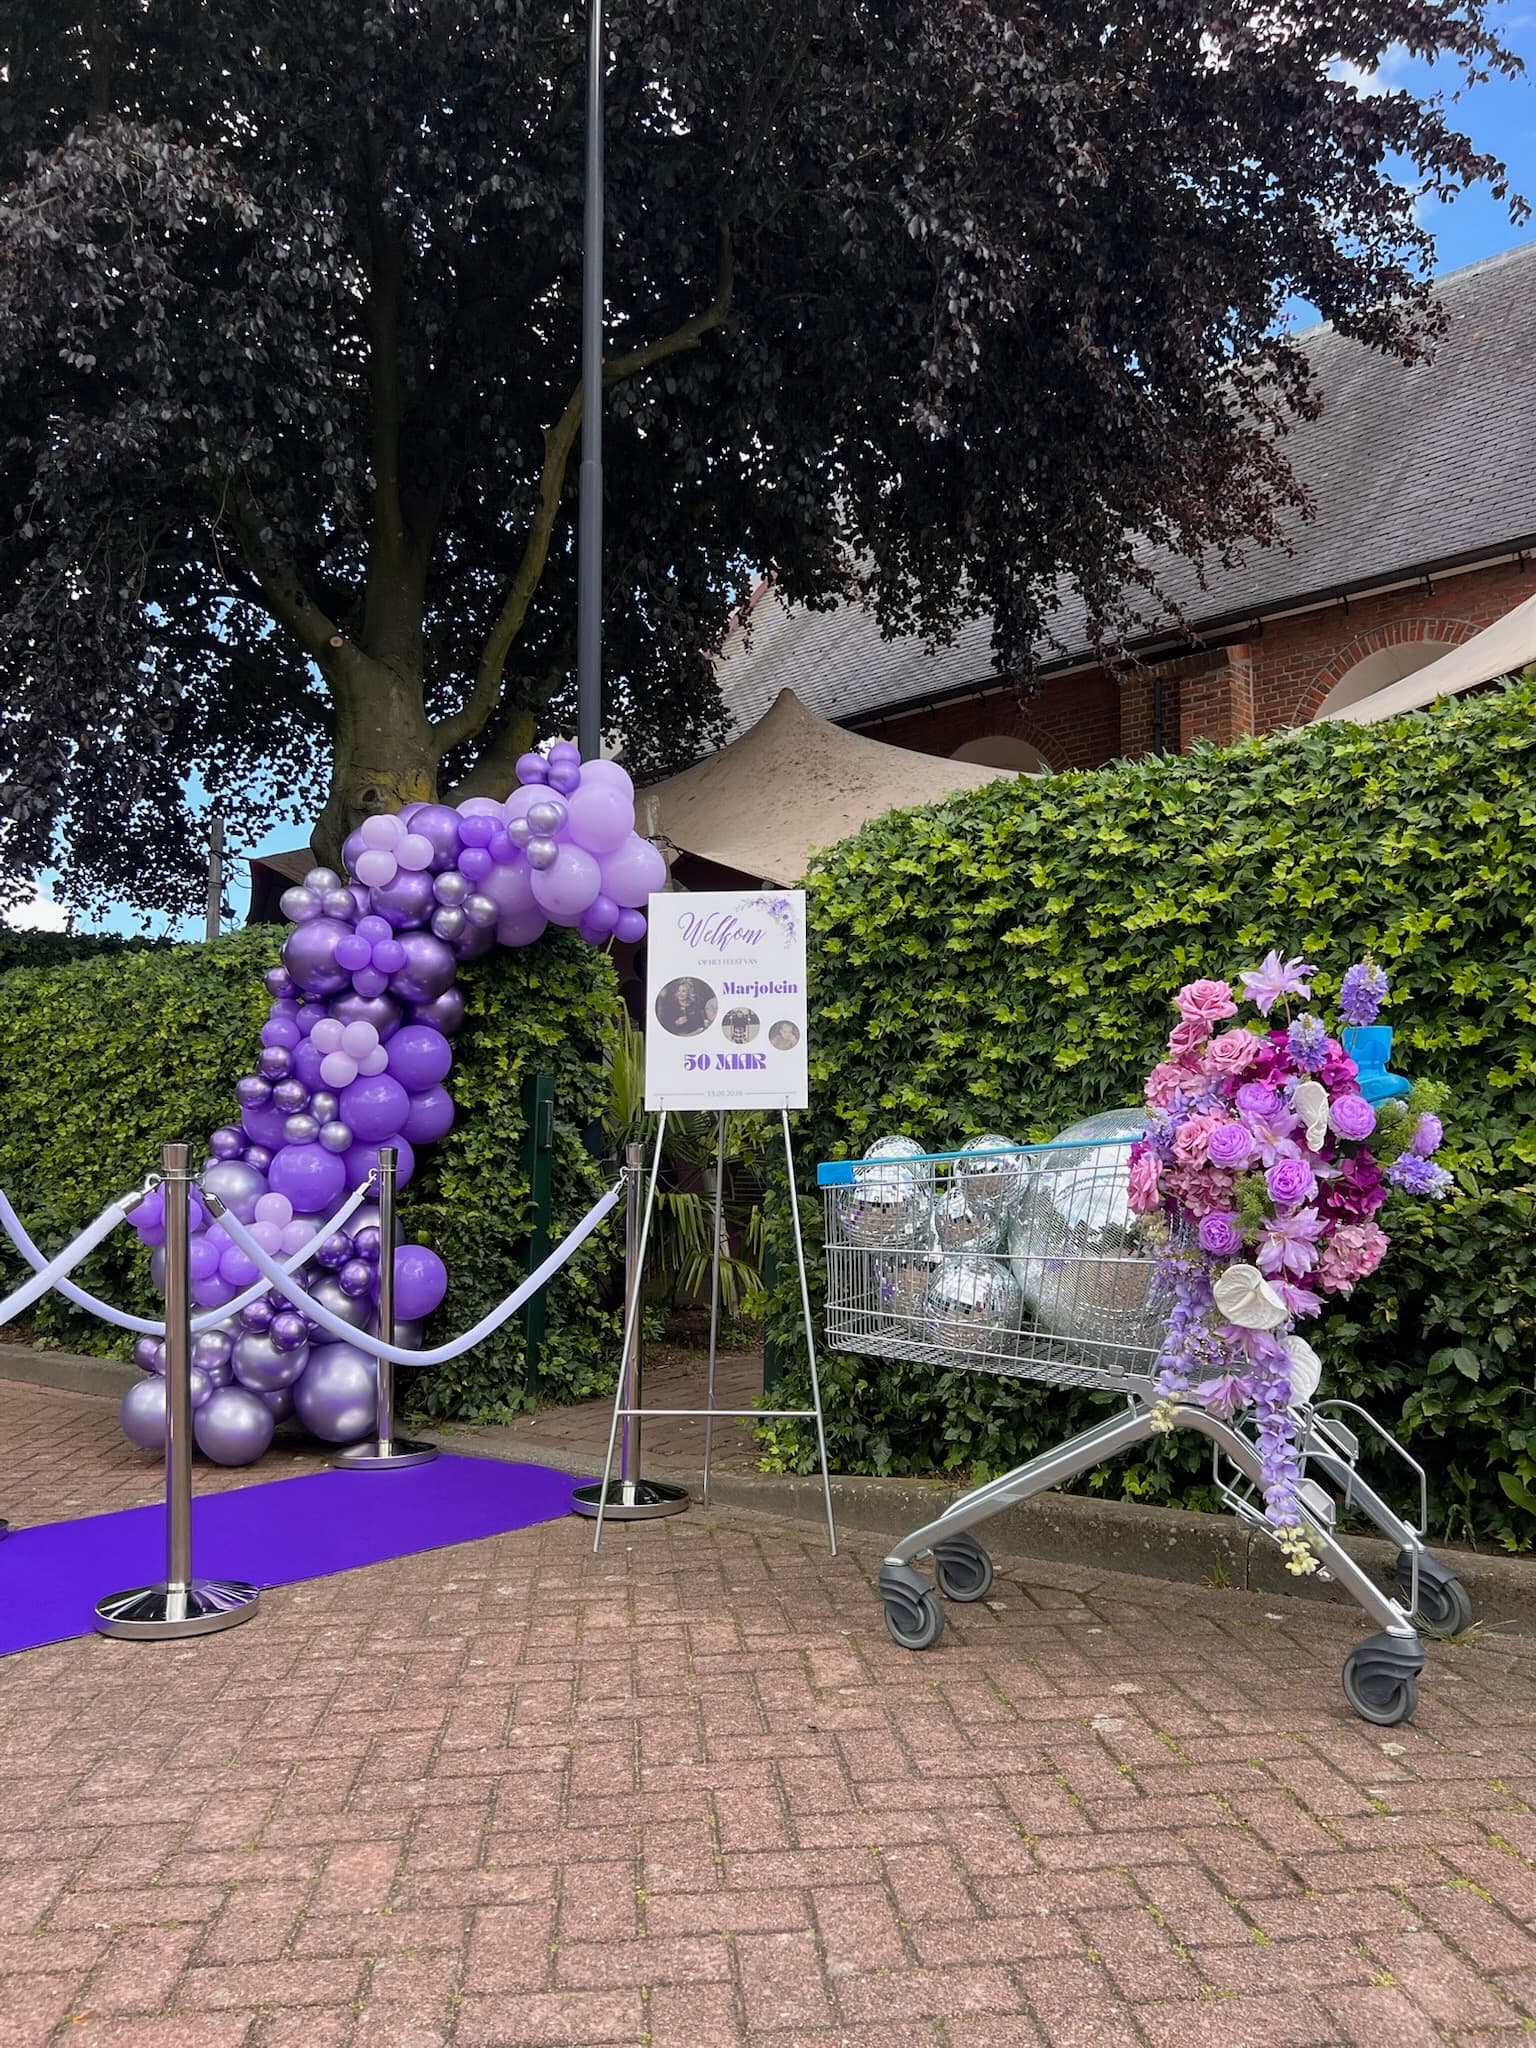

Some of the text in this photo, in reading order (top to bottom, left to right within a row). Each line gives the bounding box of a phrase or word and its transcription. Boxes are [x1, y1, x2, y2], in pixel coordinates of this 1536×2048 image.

[677, 911, 766, 952] Welkom
[722, 980, 798, 998] Marjolein
[684, 1053, 767, 1071] 50 JAAR
